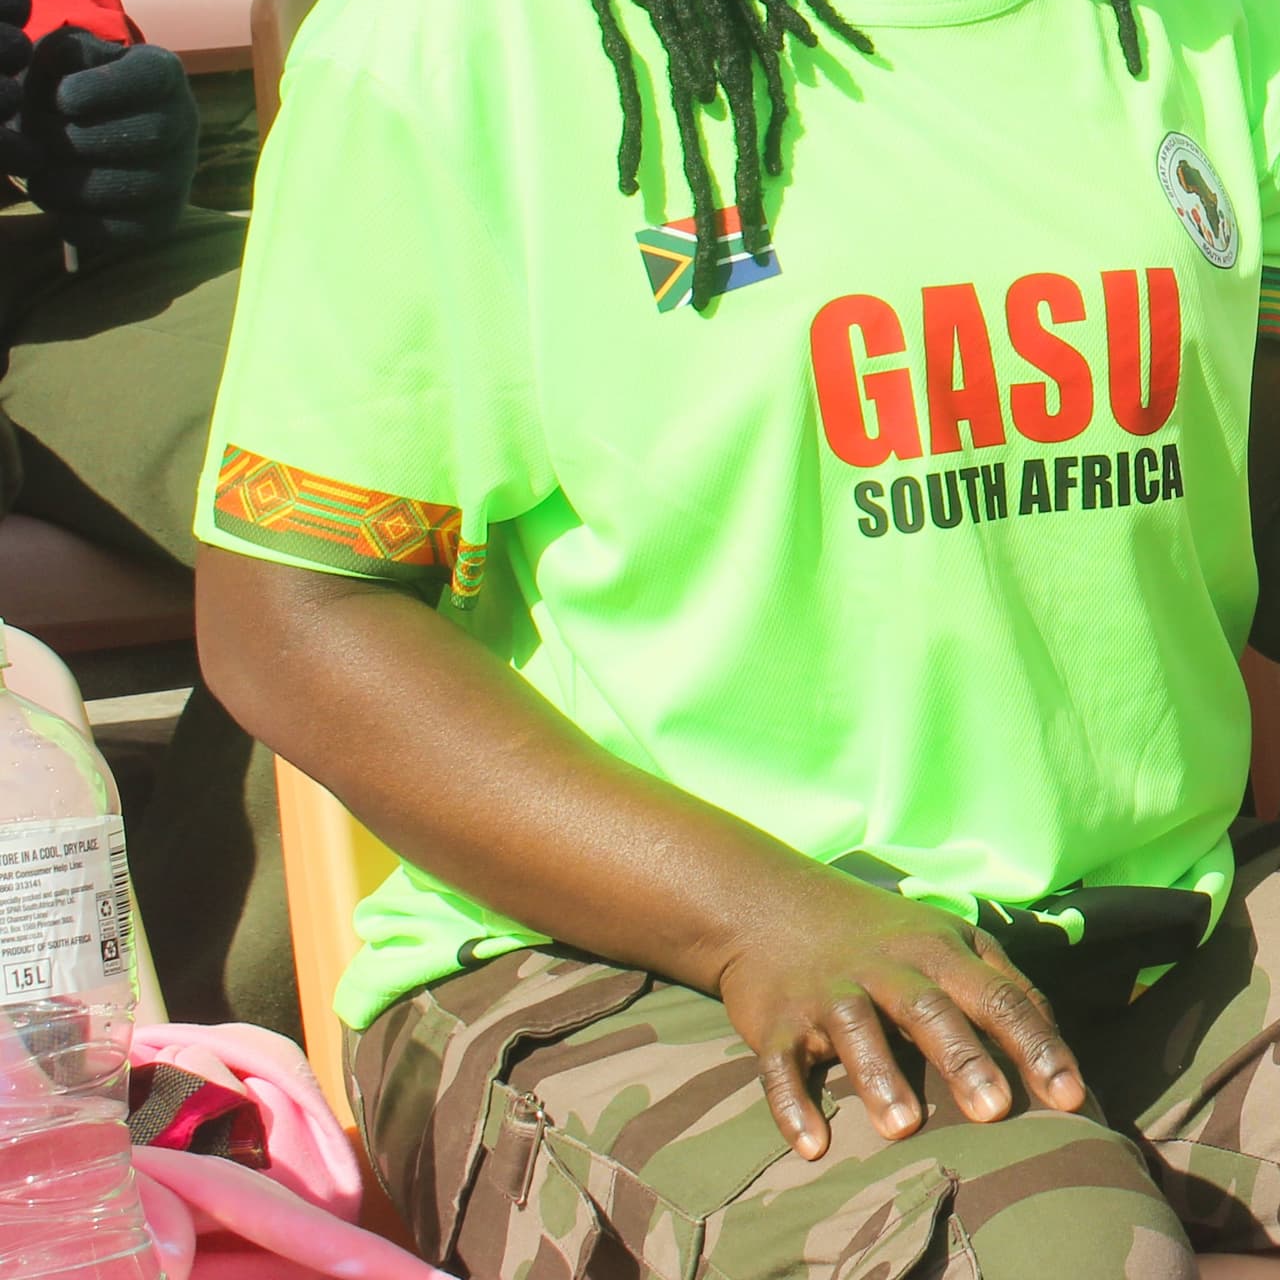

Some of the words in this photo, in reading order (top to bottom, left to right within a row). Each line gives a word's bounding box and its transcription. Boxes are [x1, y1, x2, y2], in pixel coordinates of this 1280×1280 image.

[810, 268, 1182, 468] GASU
[854, 462, 1009, 538] SOUTH
[1018, 443, 1184, 516] AFRICA
[21, 850, 30, 863] IN
[32, 849, 39, 862] A
[63, 841, 80, 856] DRY
[2, 943, 36, 958] PRODUCT
[37, 942, 46, 952] OF
[47, 938, 71, 950] SOUTH
